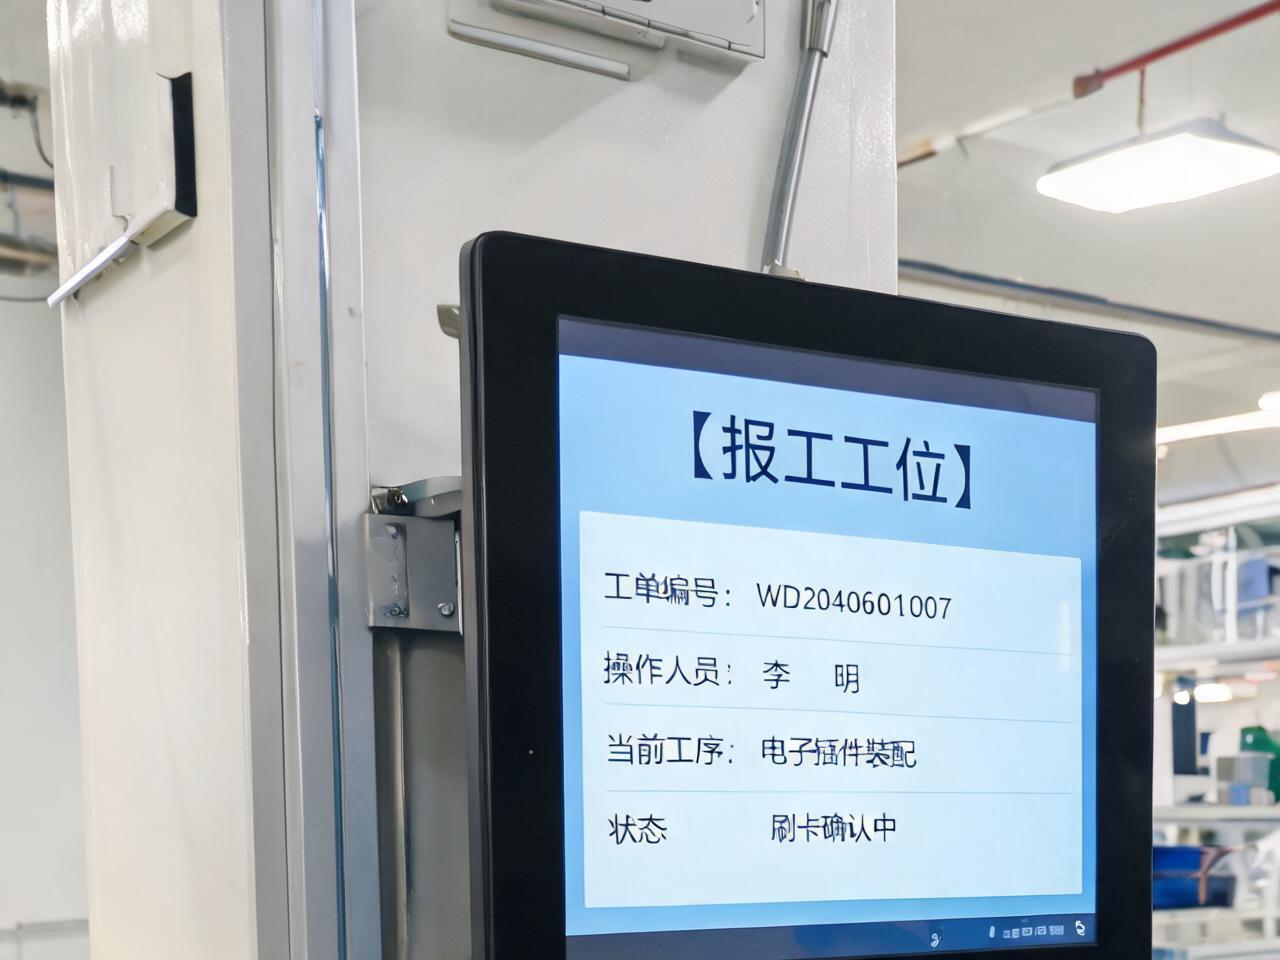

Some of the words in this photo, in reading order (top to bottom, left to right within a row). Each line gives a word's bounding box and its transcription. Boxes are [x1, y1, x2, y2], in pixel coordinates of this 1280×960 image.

[692, 410, 971, 510] 【报工工位】
[756, 582, 952, 620] WD2040601007
[762, 659, 791, 690] 李
[834, 663, 860, 694] 明
[607, 732, 734, 766] 当前工序：
[607, 813, 668, 846] 状态
